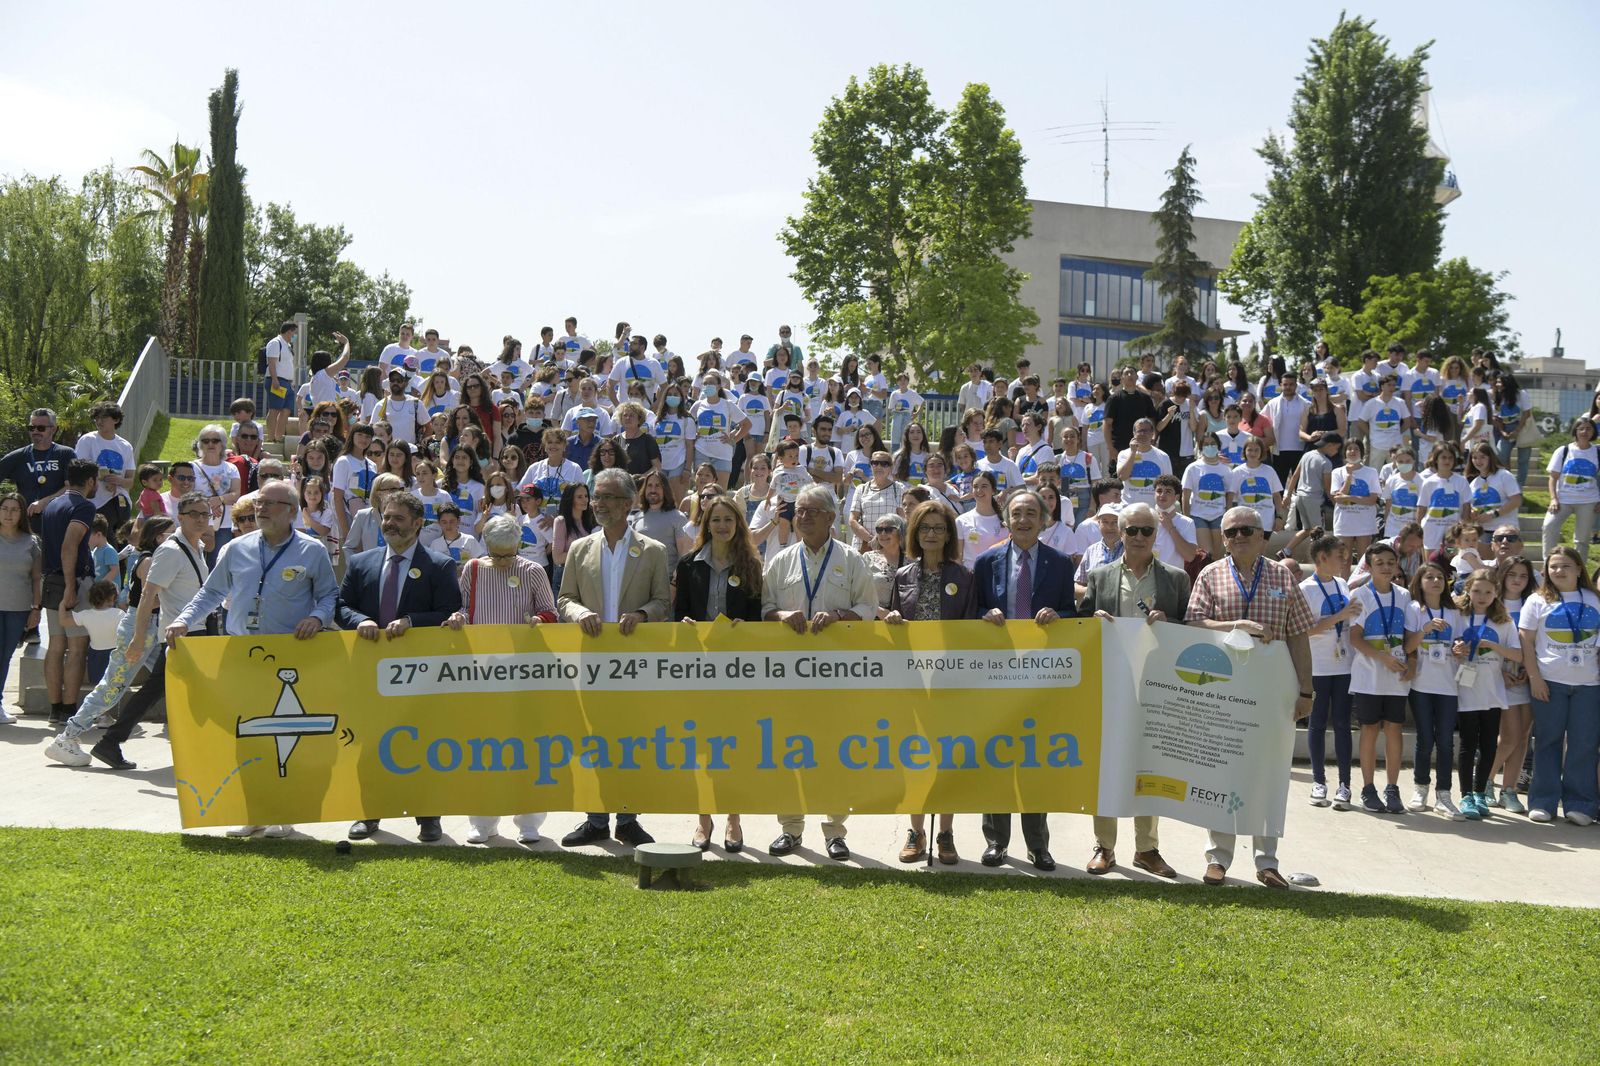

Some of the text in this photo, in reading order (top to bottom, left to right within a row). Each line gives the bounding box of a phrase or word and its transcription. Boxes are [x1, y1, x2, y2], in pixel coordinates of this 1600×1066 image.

[27, 460, 59, 473] VANS
[437, 660, 579, 683] Aniversario
[586, 663, 601, 685] y
[608, 659, 648, 680] 24ª
[656, 659, 717, 679] Feria
[725, 657, 756, 679] de
[764, 657, 786, 679] la
[794, 657, 884, 679] Ciencia
[906, 657, 1073, 672] PARQUE de las CIENCIAS
[1145, 680, 1257, 706] Consorcio Parque de las Ciencias
[378, 717, 1084, 785] Compartir la ciencia
[1190, 786, 1228, 804] FECYT
